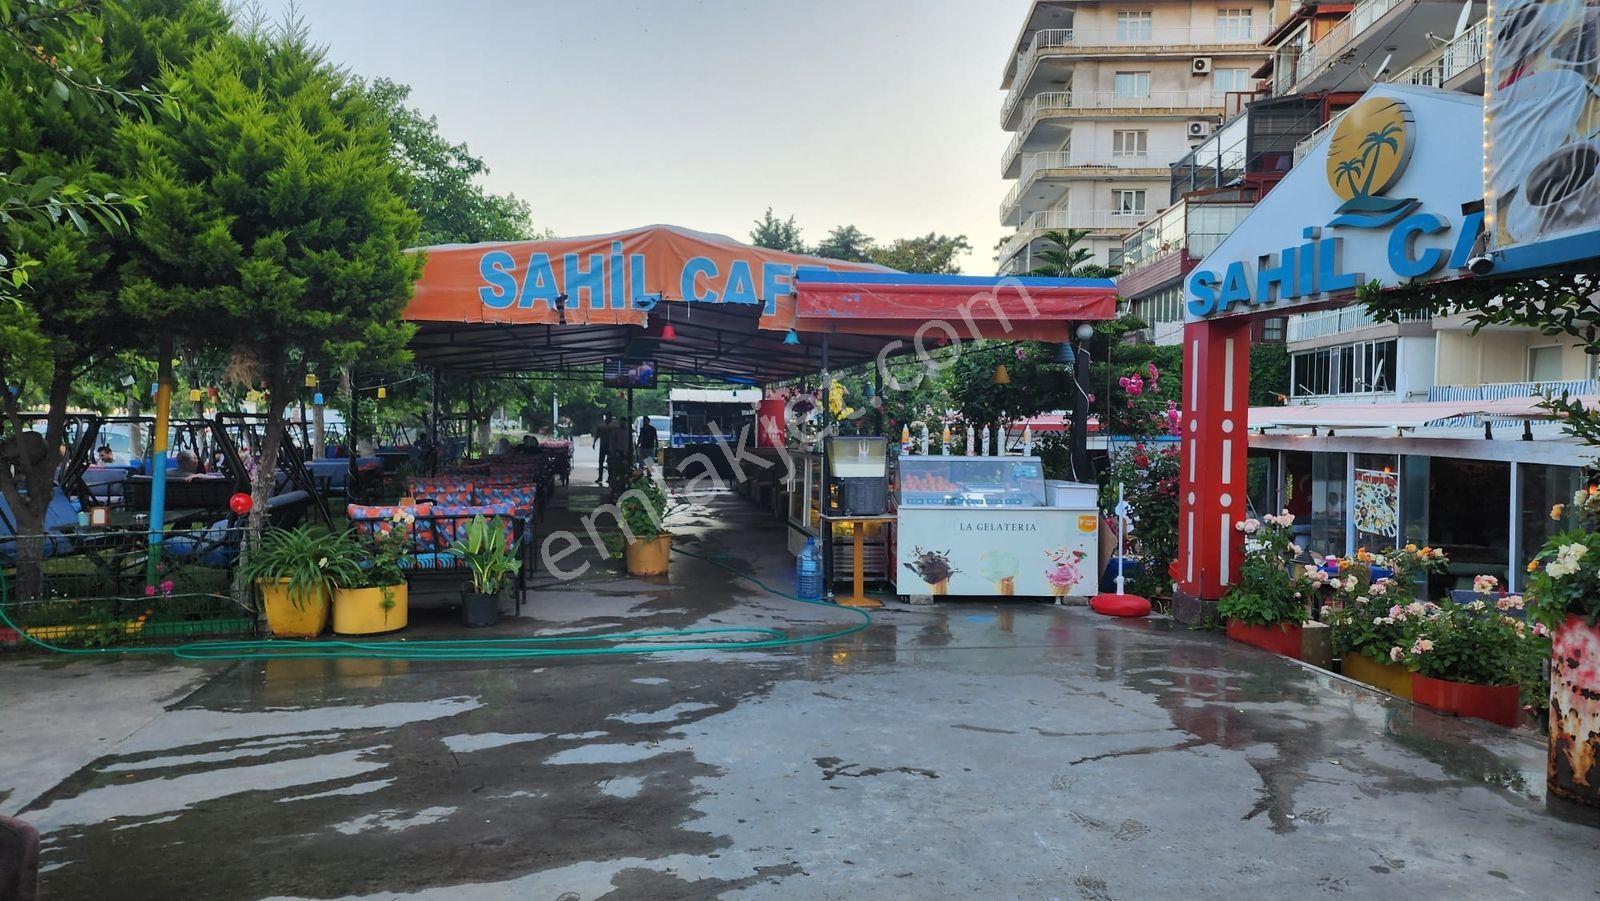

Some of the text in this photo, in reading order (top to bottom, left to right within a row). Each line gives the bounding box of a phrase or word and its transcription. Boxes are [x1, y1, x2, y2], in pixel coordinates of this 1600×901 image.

[479, 241, 829, 317] SAHİL CAF
[1189, 226, 1365, 317] SAHİL
[960, 522, 1037, 531] LA GELATERIA
